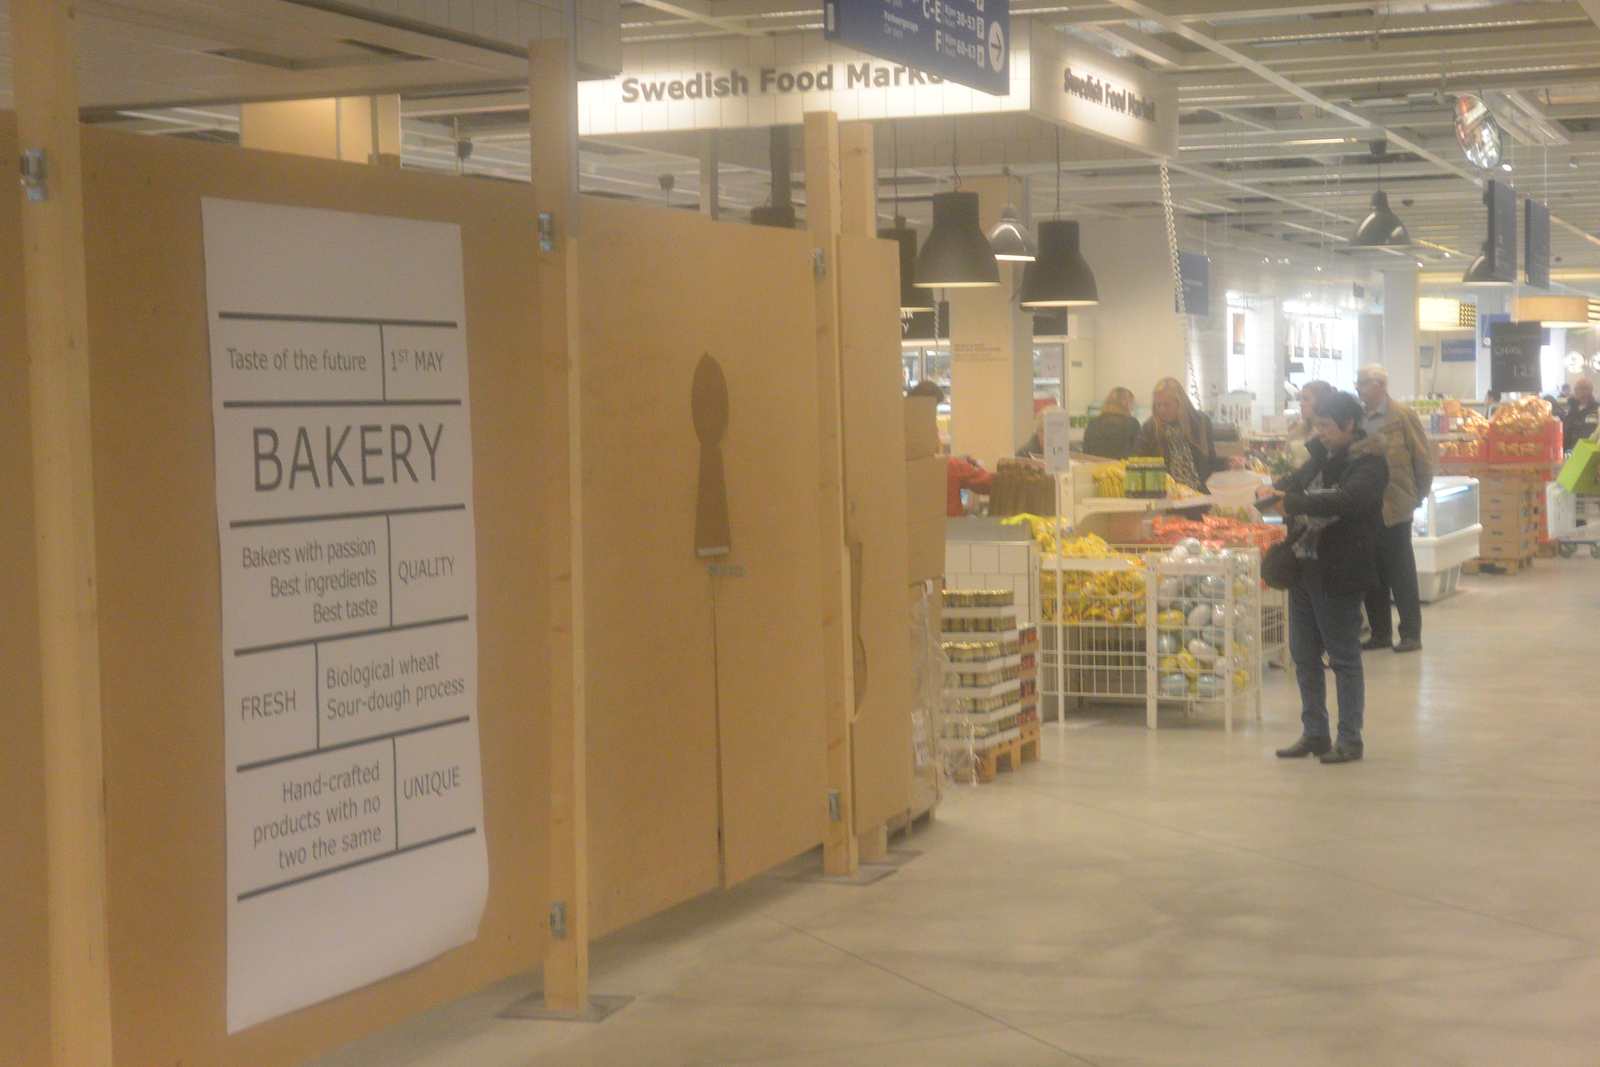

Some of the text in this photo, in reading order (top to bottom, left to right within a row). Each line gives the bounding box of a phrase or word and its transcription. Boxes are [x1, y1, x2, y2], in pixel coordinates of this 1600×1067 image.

[923, 0, 941, 23] C-E
[935, 29, 942, 52] F
[621, 62, 945, 103] Swedish Food Marke
[226, 347, 367, 372] Taste of the future
[414, 351, 444, 372] MAY
[252, 422, 444, 492] BAKERY
[242, 536, 377, 569] Bakers with passion
[270, 567, 377, 598] Best ingredients
[398, 556, 455, 585] QUALITY
[313, 598, 378, 624] Best taste
[327, 650, 441, 690] Biological wheat
[241, 688, 297, 721] FRESH
[327, 676, 466, 721] Sour-dough process
[282, 759, 380, 803] Hand-crafted
[403, 765, 461, 800] UNIQUE
[253, 795, 381, 849] products with no
[278, 825, 382, 870] two the same
